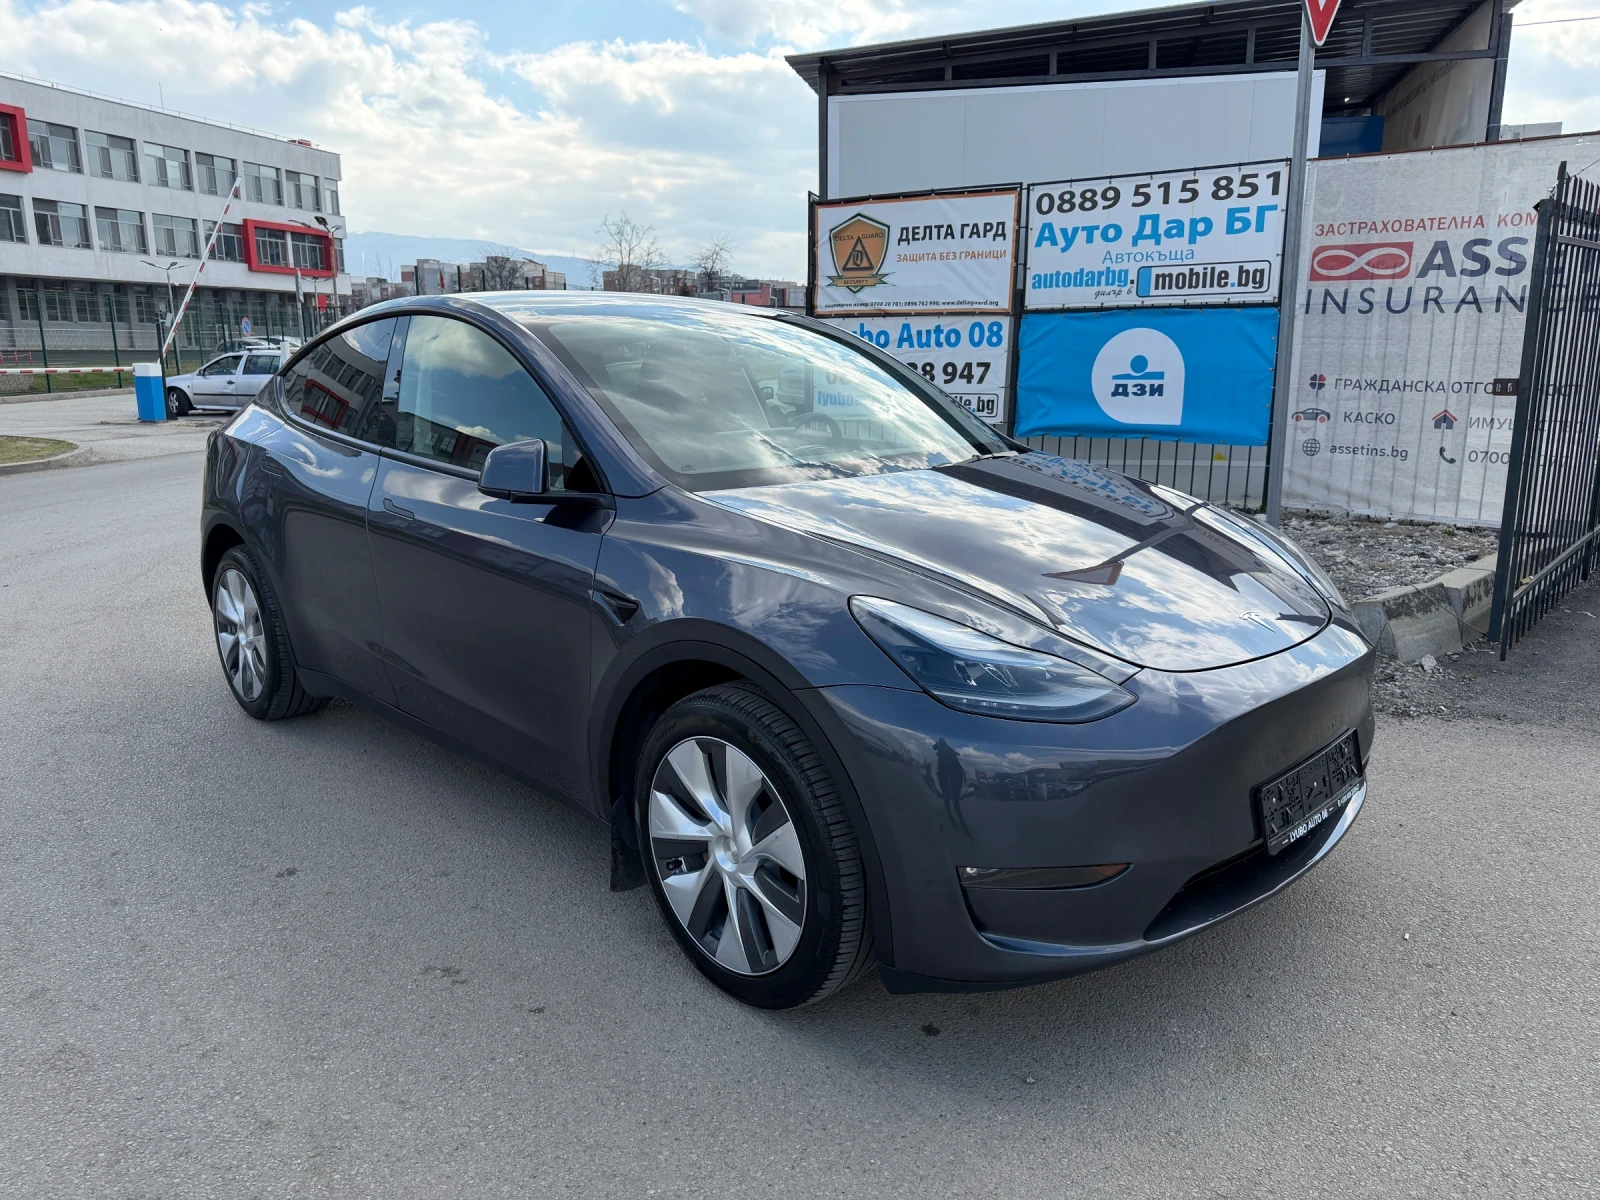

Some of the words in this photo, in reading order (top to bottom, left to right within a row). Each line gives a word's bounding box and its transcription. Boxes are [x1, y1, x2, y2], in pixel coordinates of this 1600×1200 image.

[1036, 185, 1121, 216] 0889
[1131, 179, 1200, 207] 515
[1211, 170, 1282, 200] 851
[861, 232, 884, 240] GUARD
[898, 224, 955, 245] ДЕЛТА
[960, 221, 1007, 241] ГАРД
[1034, 222, 1123, 253] Ауто
[1131, 213, 1214, 246] Дар
[1225, 204, 1278, 235] БГ
[1314, 214, 1485, 237] ЗАСТРАХОВАТЕЛНА
[1497, 212, 1539, 228] КОМ
[896, 252, 937, 264] ЗАЩИТА
[939, 251, 957, 261] БЕЗ
[959, 249, 1007, 261] ГРАНИЦИ
[1101, 249, 1195, 265] Автокъща
[1416, 236, 1529, 278] ASS
[1154, 265, 1266, 290] mobile.bg
[1304, 284, 1528, 315] INSURAN
[897, 323, 961, 349] Auto
[968, 321, 1003, 347] 08
[942, 361, 991, 385] 947
[1111, 383, 1164, 397] ДЗИ
[1334, 378, 1446, 394] ГРАЖДАНСКА
[1343, 411, 1395, 425] КАСКО
[1330, 444, 1408, 461] assetins.bg
[1290, 824, 1308, 842] LYUBO
[1308, 813, 1322, 831] AUTO
